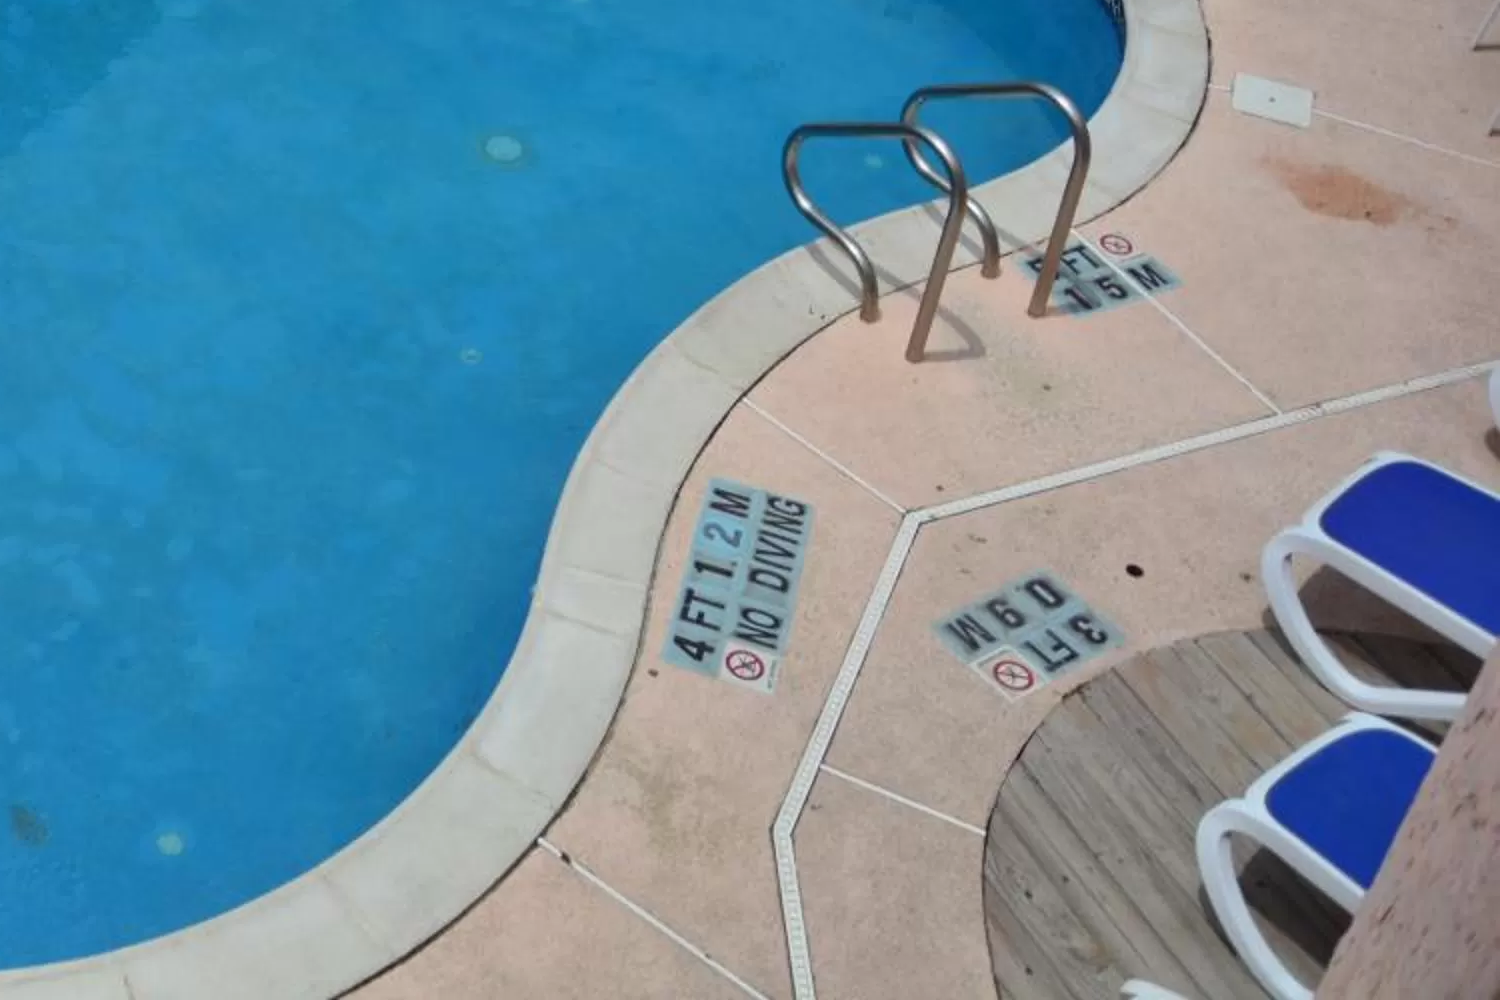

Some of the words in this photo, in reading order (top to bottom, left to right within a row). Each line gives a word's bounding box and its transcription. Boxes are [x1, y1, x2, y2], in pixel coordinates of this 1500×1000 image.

[1127, 263, 1170, 291] M
[709, 487, 752, 519] M
[748, 494, 807, 595] DIVING
[679, 587, 726, 633] FT
[733, 606, 784, 650] NO
[1068, 614, 1109, 645] 3
[673, 633, 716, 663] 4
[945, 612, 998, 652] M
[1023, 628, 1080, 672] FT
